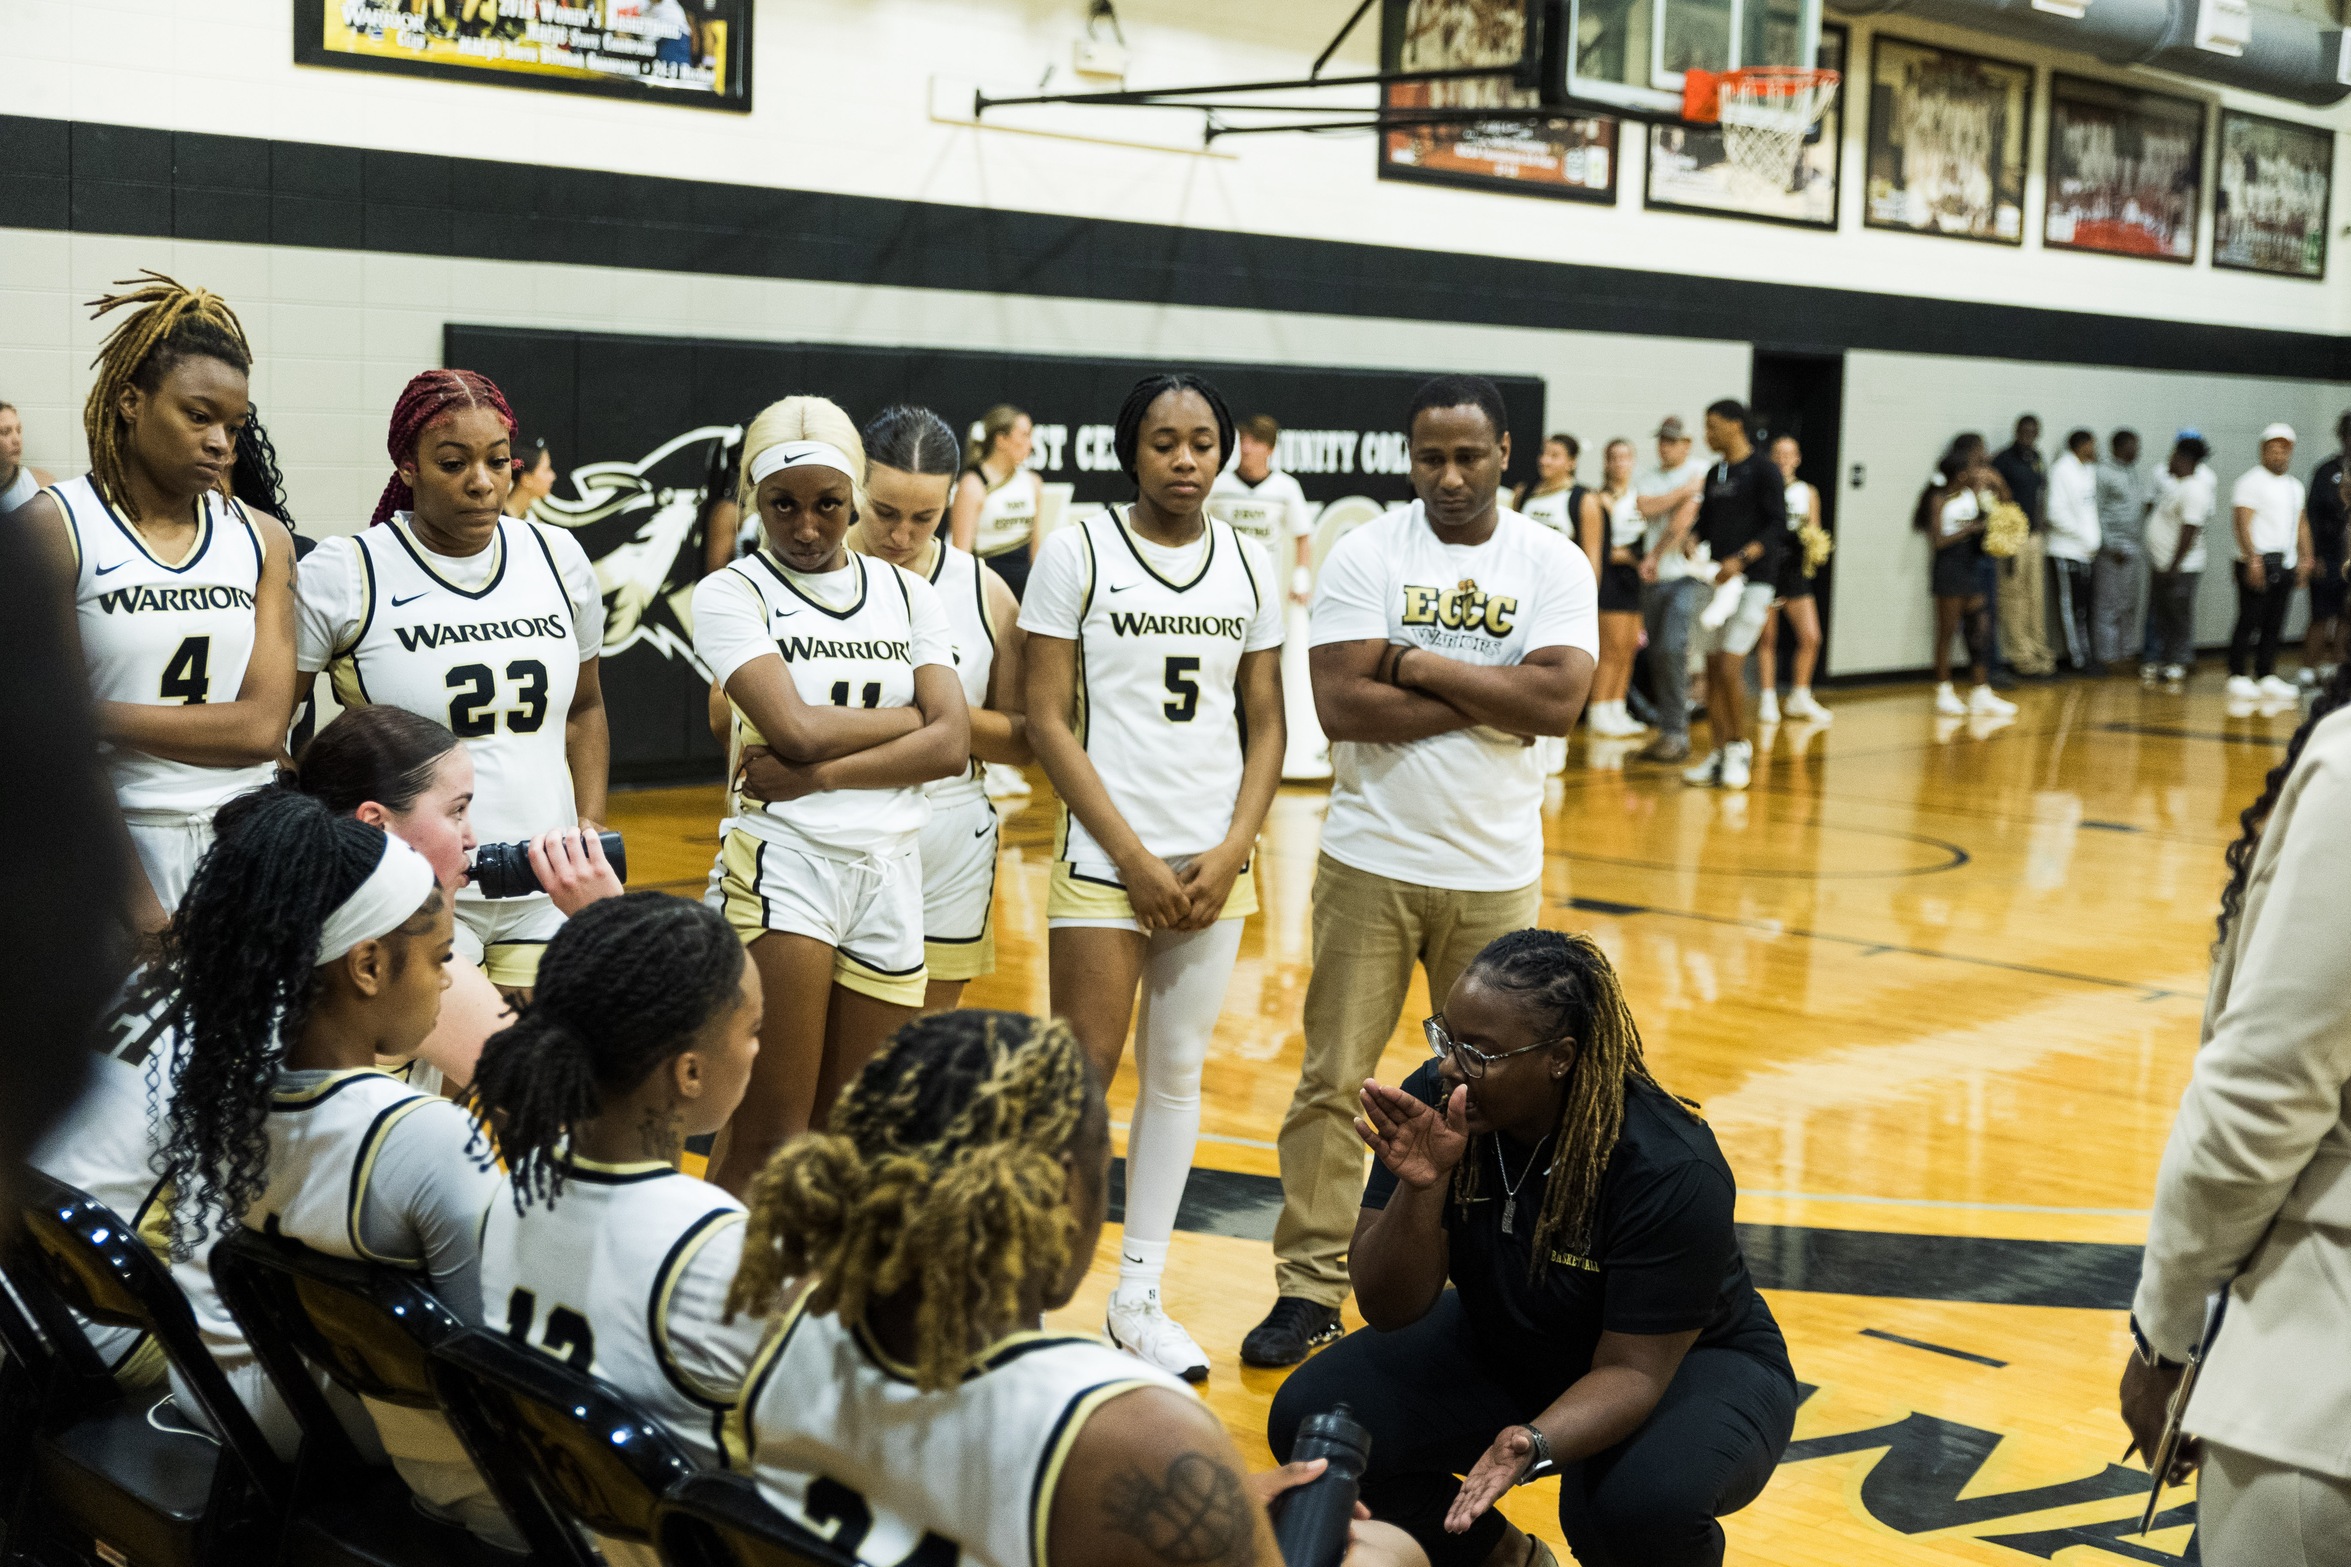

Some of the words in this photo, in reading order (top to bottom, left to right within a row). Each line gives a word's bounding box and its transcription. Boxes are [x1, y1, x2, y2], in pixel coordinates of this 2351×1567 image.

[393, 614, 567, 652] WARRIORS
[1109, 612, 1246, 641] WARRIORS
[1402, 584, 1518, 639] ECCC
[158, 633, 213, 706] 4
[443, 657, 549, 739] 23
[1162, 655, 1202, 723] 5
